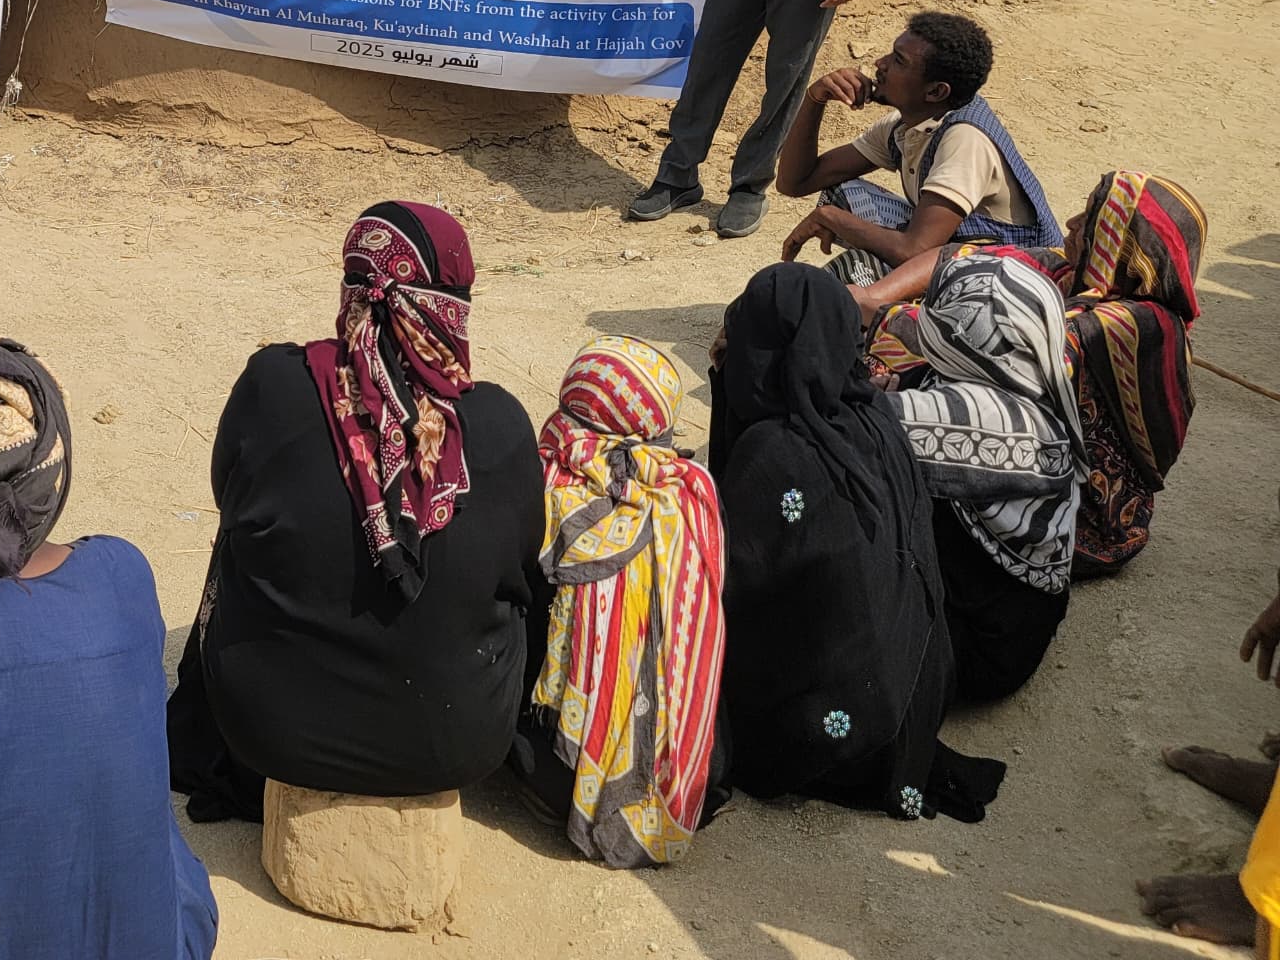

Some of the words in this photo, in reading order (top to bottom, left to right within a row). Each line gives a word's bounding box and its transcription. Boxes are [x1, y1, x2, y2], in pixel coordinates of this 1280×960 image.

[475, 1, 514, 17] from
[520, 4, 545, 20] the
[550, 8, 607, 25] activity
[611, 8, 647, 22] Cash
[653, 7, 676, 21] for
[275, 7, 292, 20] Al
[297, 11, 368, 31] Muharaq,
[373, 18, 458, 39] Ku'aydinah
[463, 28, 493, 42] and
[498, 30, 570, 50] Washhah
[576, 39, 590, 51] at
[596, 37, 645, 54] Hajjah
[650, 37, 685, 51] Gov
[336, 39, 385, 58] 2025
[392, 49, 433, 67] يوليو
[438, 53, 479, 70] شهر
